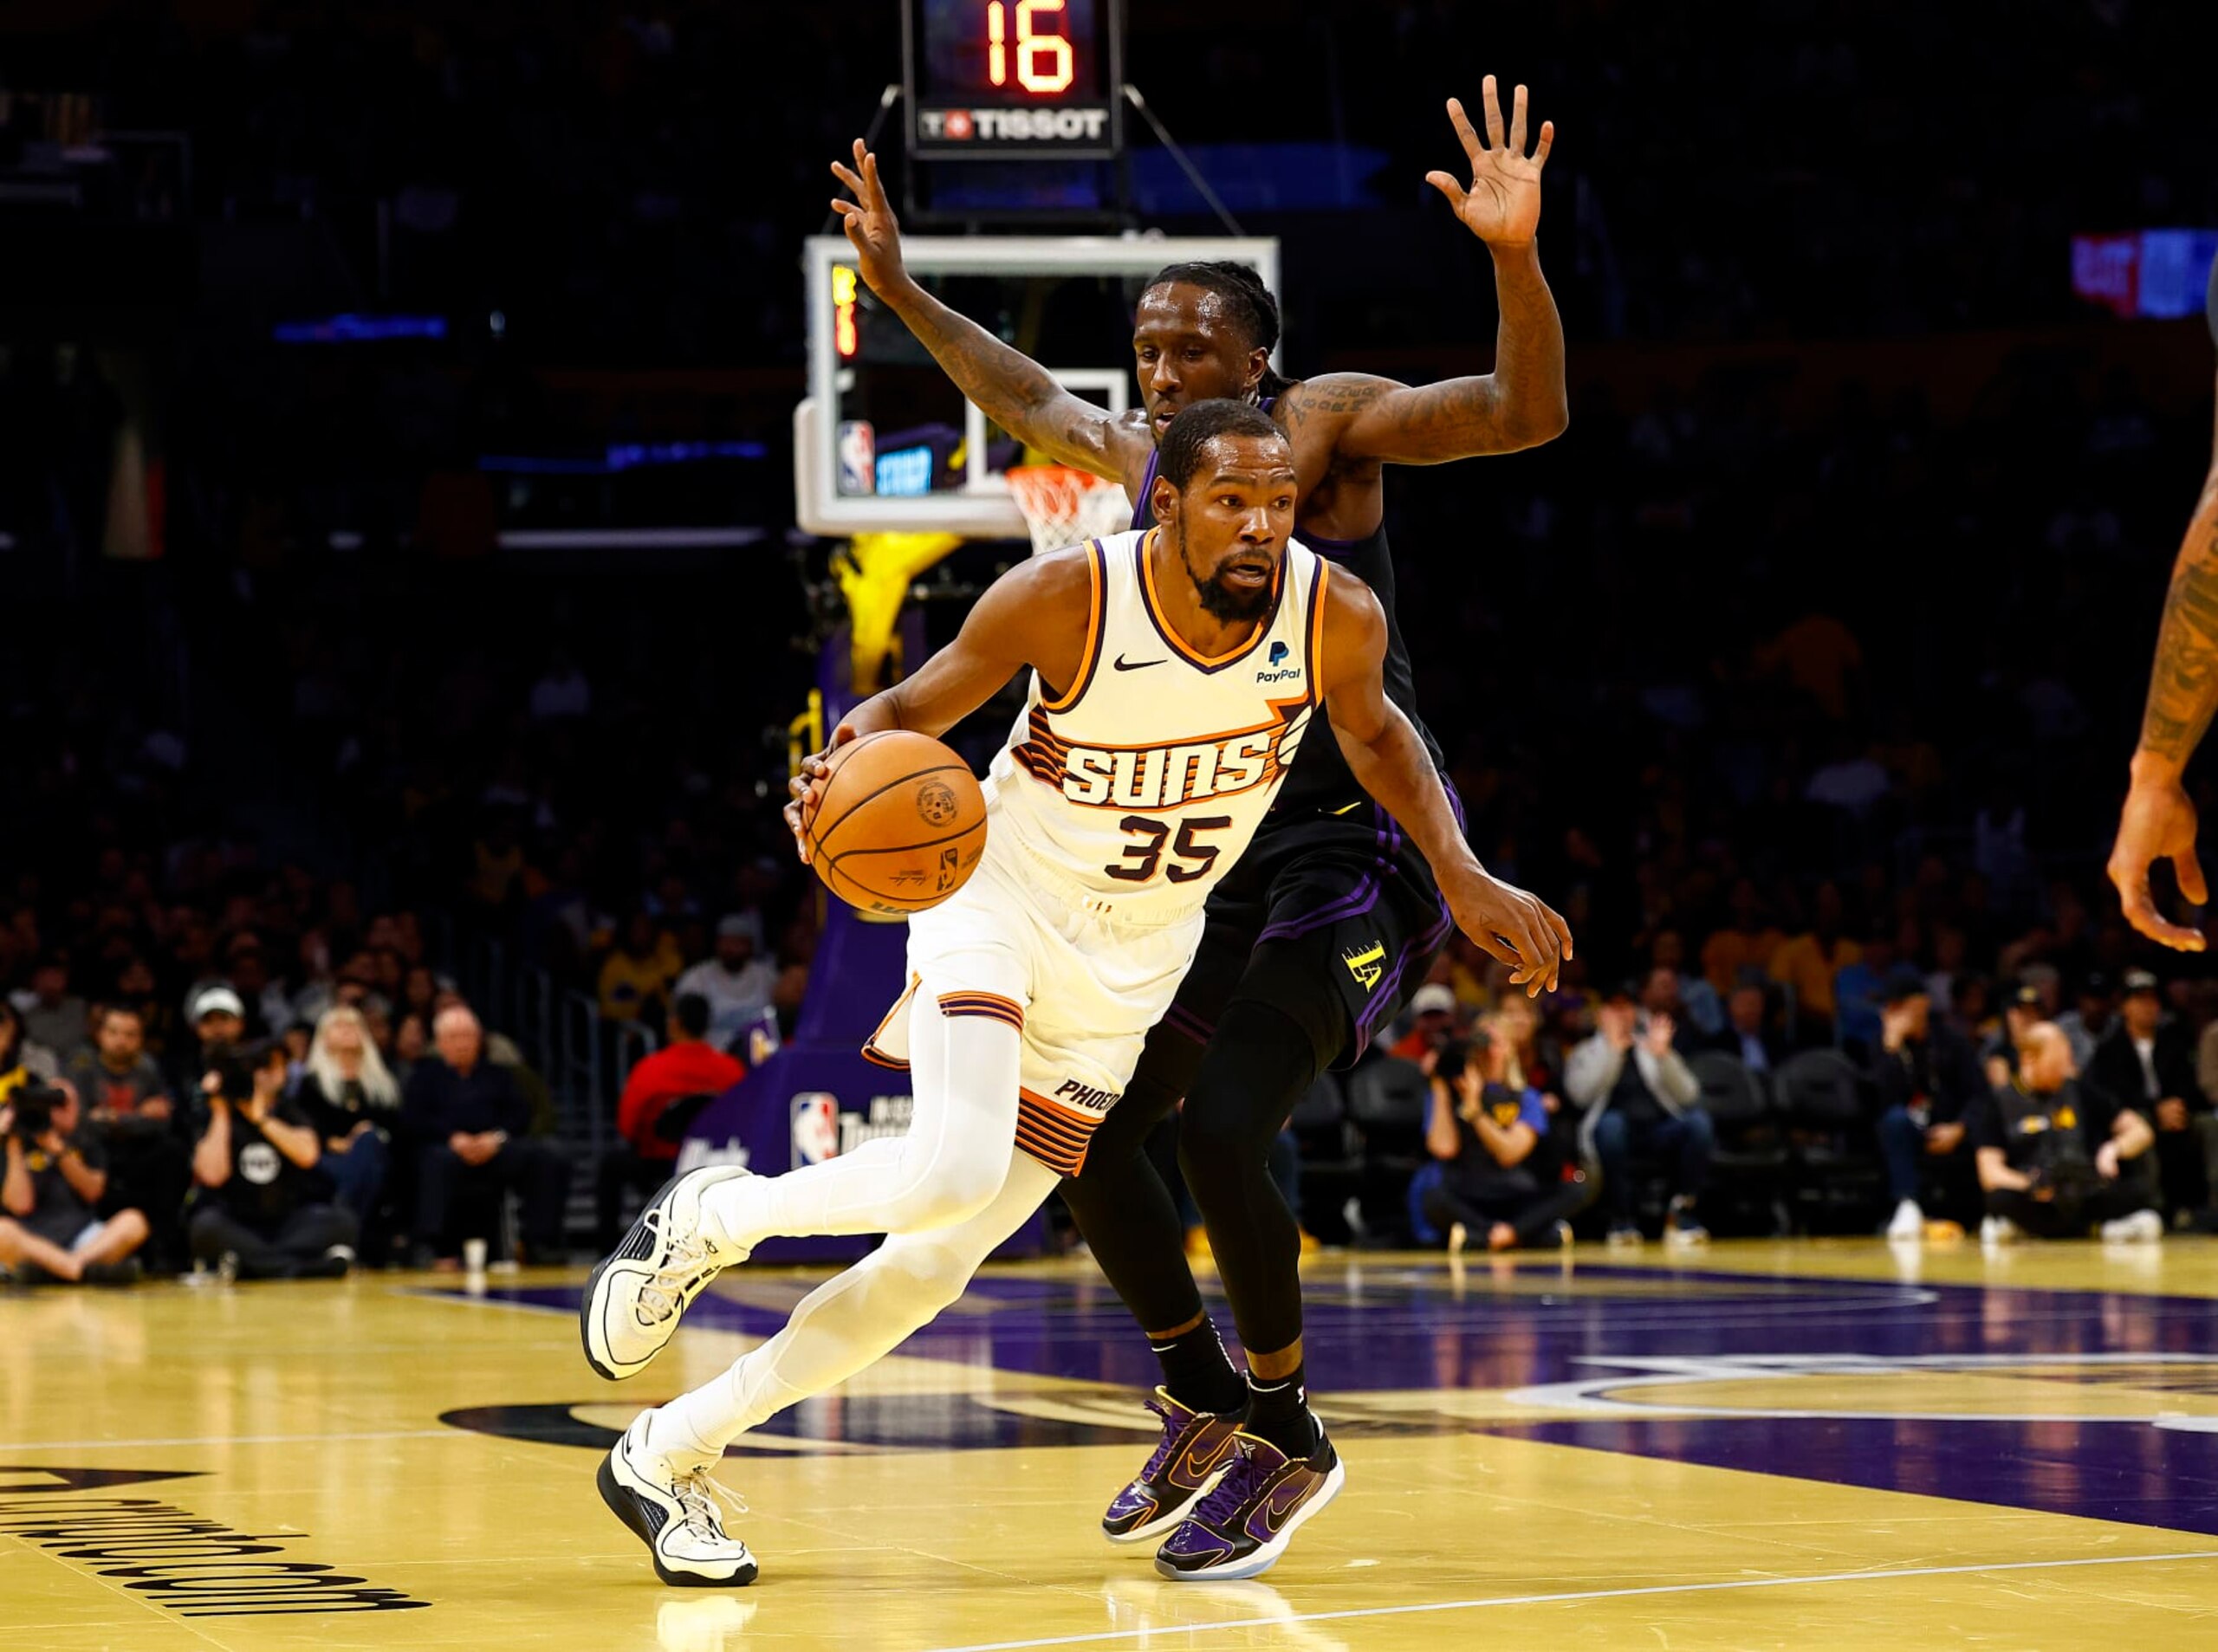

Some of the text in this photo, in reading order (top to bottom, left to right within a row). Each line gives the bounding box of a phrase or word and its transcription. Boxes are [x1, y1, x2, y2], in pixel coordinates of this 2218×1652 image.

[988, 0, 1073, 93] 16
[973, 108, 1108, 139] TISSOT
[1256, 668, 1300, 683] PayPal
[1062, 732, 1270, 807] SUNS
[1104, 815, 1232, 884] 35
